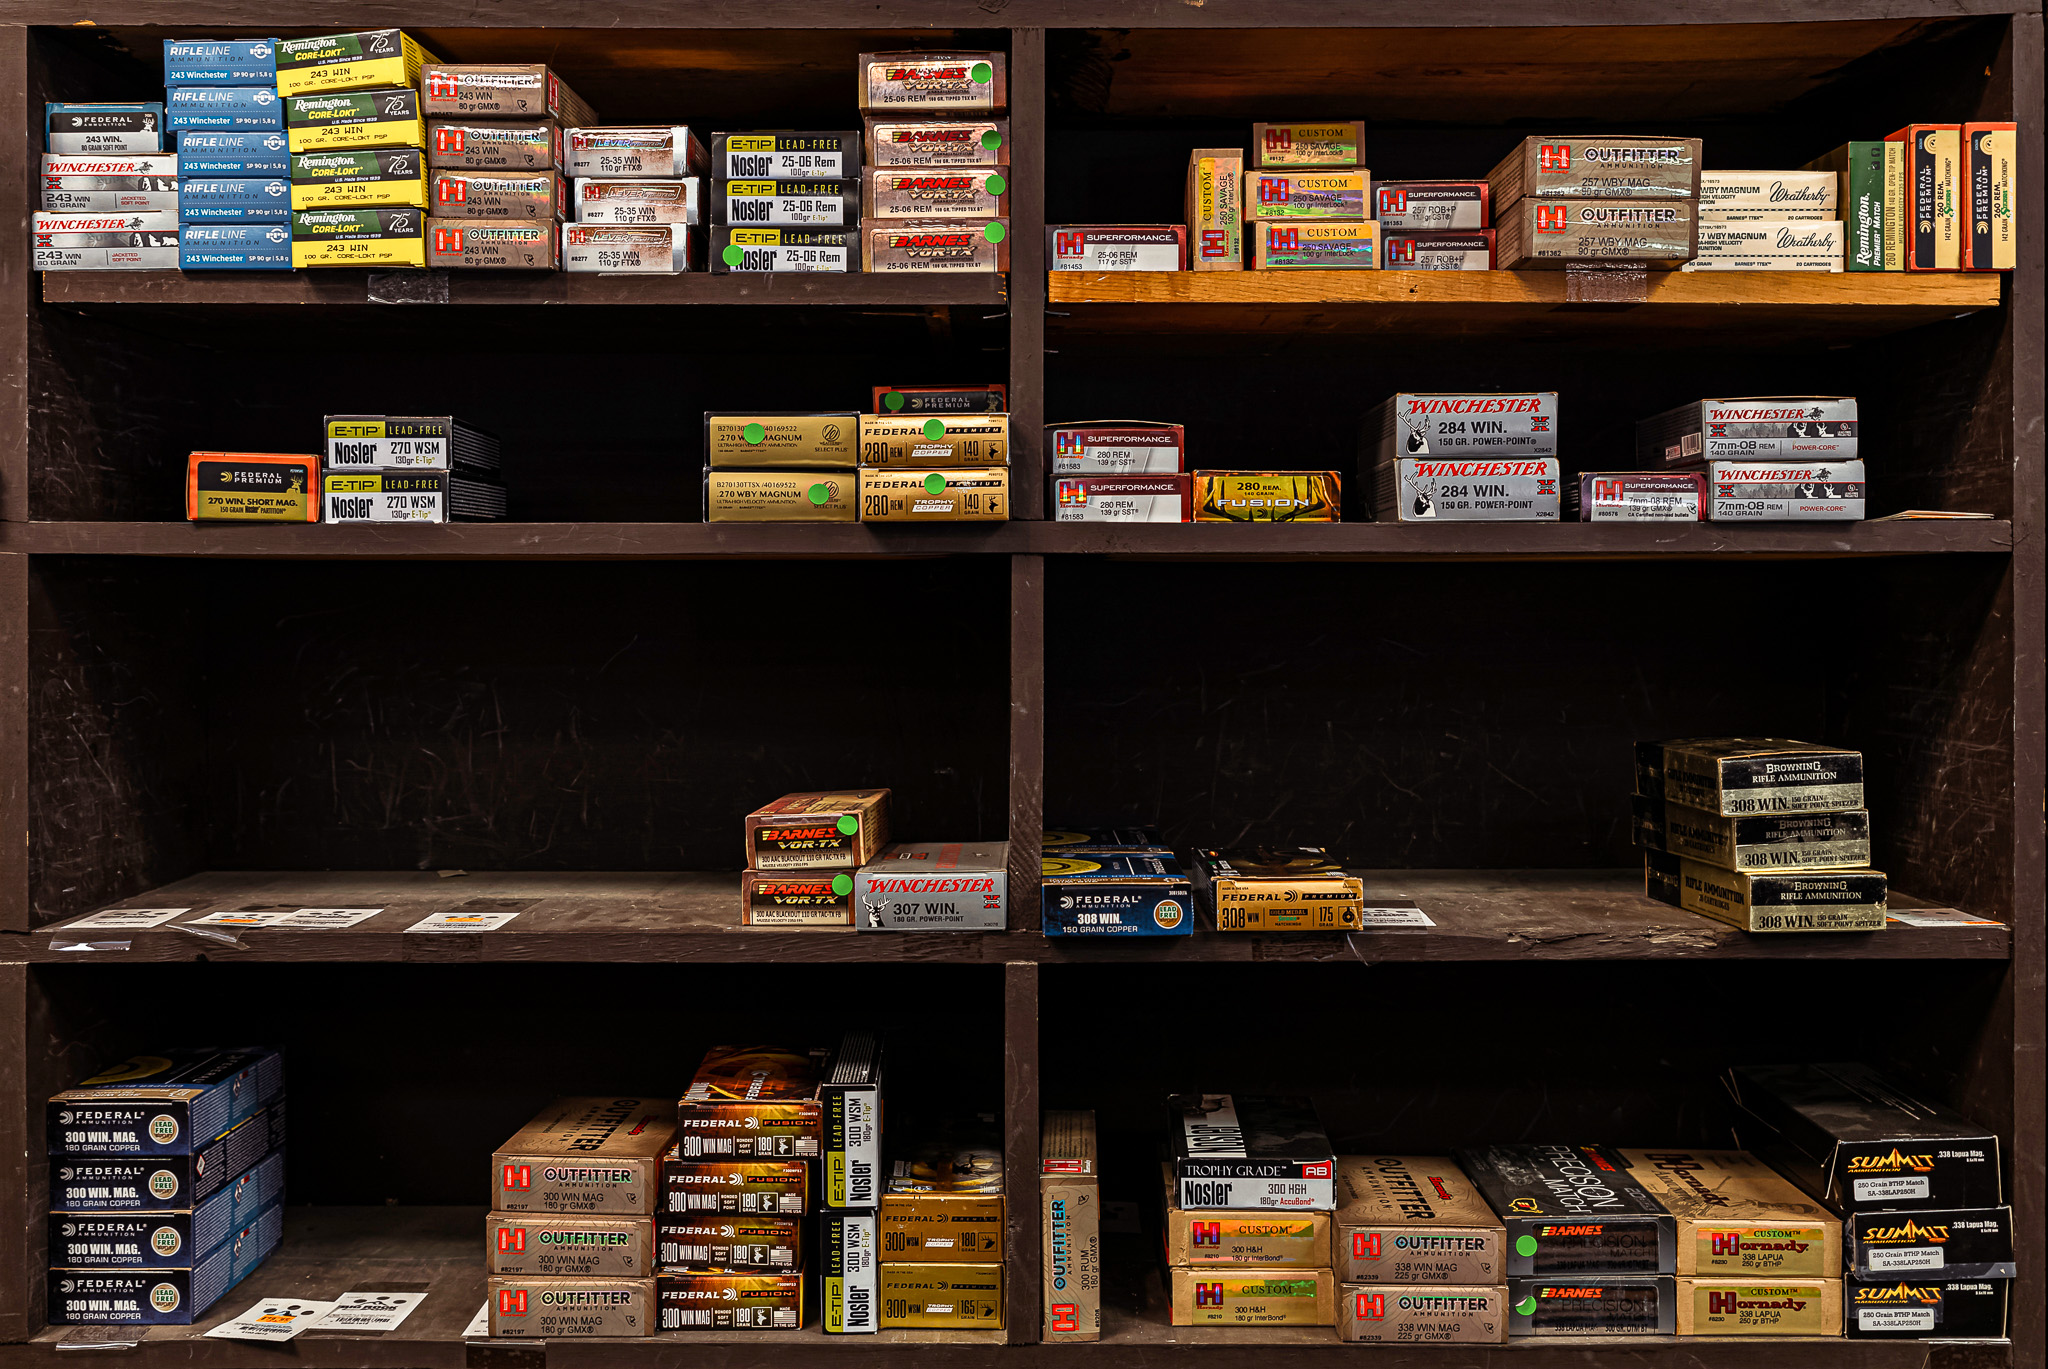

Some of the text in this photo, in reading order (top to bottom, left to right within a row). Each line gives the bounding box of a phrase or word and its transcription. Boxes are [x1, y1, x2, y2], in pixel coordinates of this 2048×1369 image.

[170, 46, 230, 56] RIFLE LINE
[281, 39, 337, 53] Remington
[171, 71, 227, 79] 243 Winchester
[310, 70, 328, 78] 243
[731, 140, 838, 150] E-TIP LEAD-FREE
[1585, 148, 1679, 162] OUTFITTER
[47, 162, 135, 174] WINCHESTER
[732, 155, 836, 176] Nosler 25-06 Rem
[1582, 178, 1650, 186] 257 WBY MAG
[46, 193, 72, 202] 243
[1769, 181, 1827, 204] Weatherby
[1220, 175, 1228, 225] 250 SAVAGE
[468, 229, 539, 240] OUTFITTER
[1307, 229, 1357, 237] CUSTOM
[1886, 206, 1896, 266] 260 REMINGTON
[481, 246, 499, 254] WIN
[1408, 398, 1541, 414] WINCHESTER
[1710, 409, 1804, 420] WINCHESTER
[1438, 421, 1507, 434] 284 WIN.
[1439, 438, 1454, 446] 150
[1710, 441, 1756, 451] 7mm-08
[335, 442, 439, 464] Nosler 270 WSM
[865, 441, 978, 463] 280 140
[234, 472, 282, 480] FEDERAL
[1237, 483, 1260, 491] 280
[247, 498, 273, 506] SHORT
[1218, 499, 1309, 507] FUSION
[1766, 762, 1821, 773] BROWNING
[1752, 772, 1837, 783] RIFLE AMMUNITION
[1731, 797, 1790, 812] 308 WIN.
[782, 854, 805, 862] BLACKOUT
[867, 879, 994, 893] WINCHESTER
[1076, 895, 1138, 904] FEDERAL
[893, 903, 959, 915] 307 WIN.
[1078, 913, 1122, 925] 308 WIN.
[1222, 907, 1333, 928] 308 175
[684, 1120, 742, 1128] FEDERAL
[849, 1098, 861, 1147] 300 WSM
[66, 1132, 138, 1142] 300 WIN. MAG.
[684, 1136, 732, 1156] 300 WIN MAG
[1848, 1148, 1935, 1170] SUMMIT
[1951, 1151, 1968, 1159] Lapua
[1970, 1150, 1985, 1158] Mag.
[544, 1167, 632, 1183] OUTFITTER
[1187, 1165, 1327, 1176] TROPHY GRADE AB
[543, 1193, 604, 1201] 300 WIN MAG
[1185, 1181, 1307, 1205] Nosler 300 H&H
[886, 1232, 919, 1251] 300 WSM
[1082, 1250, 1090, 1290] 300 RUM
[1395, 1263, 1457, 1272] 338 WIN MAG
